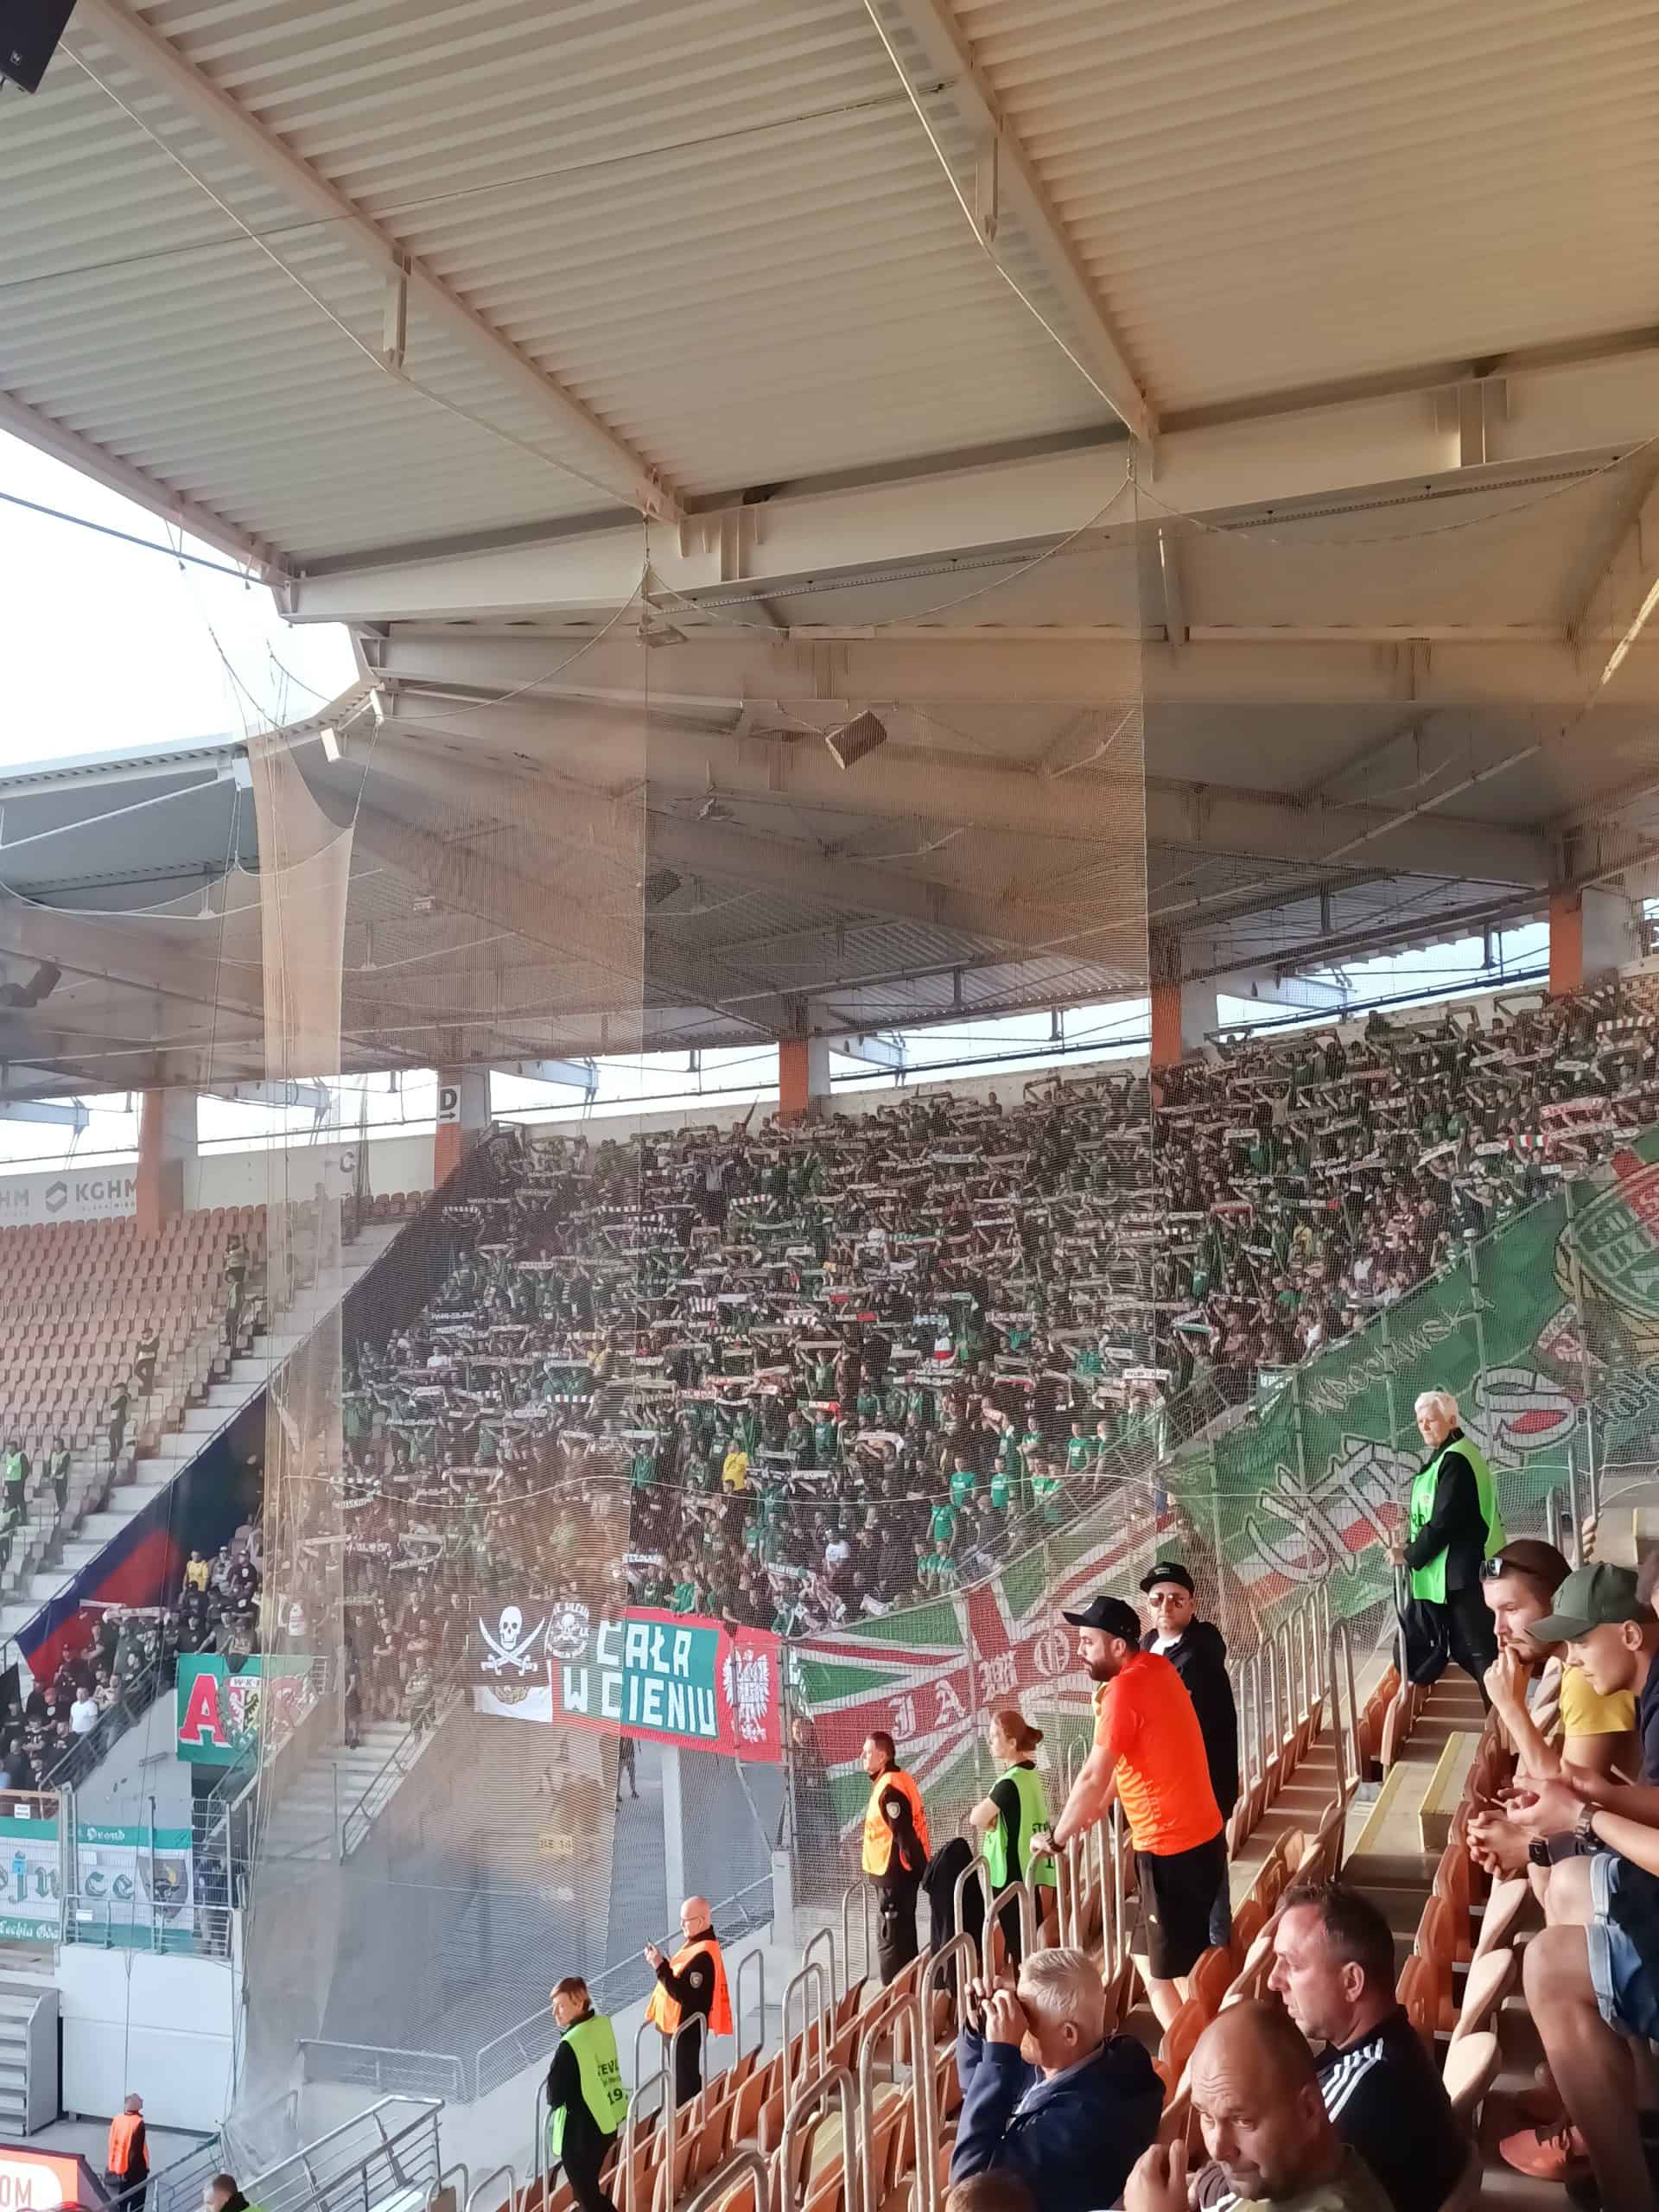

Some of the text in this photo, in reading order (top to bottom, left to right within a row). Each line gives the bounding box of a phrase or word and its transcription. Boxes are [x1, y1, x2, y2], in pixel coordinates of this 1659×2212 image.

[440, 1088, 458, 1111] D
[340, 1150, 356, 1173] C
[596, 1619, 692, 1678] CAŁA
[563, 1666, 717, 1736] W CIENIU
